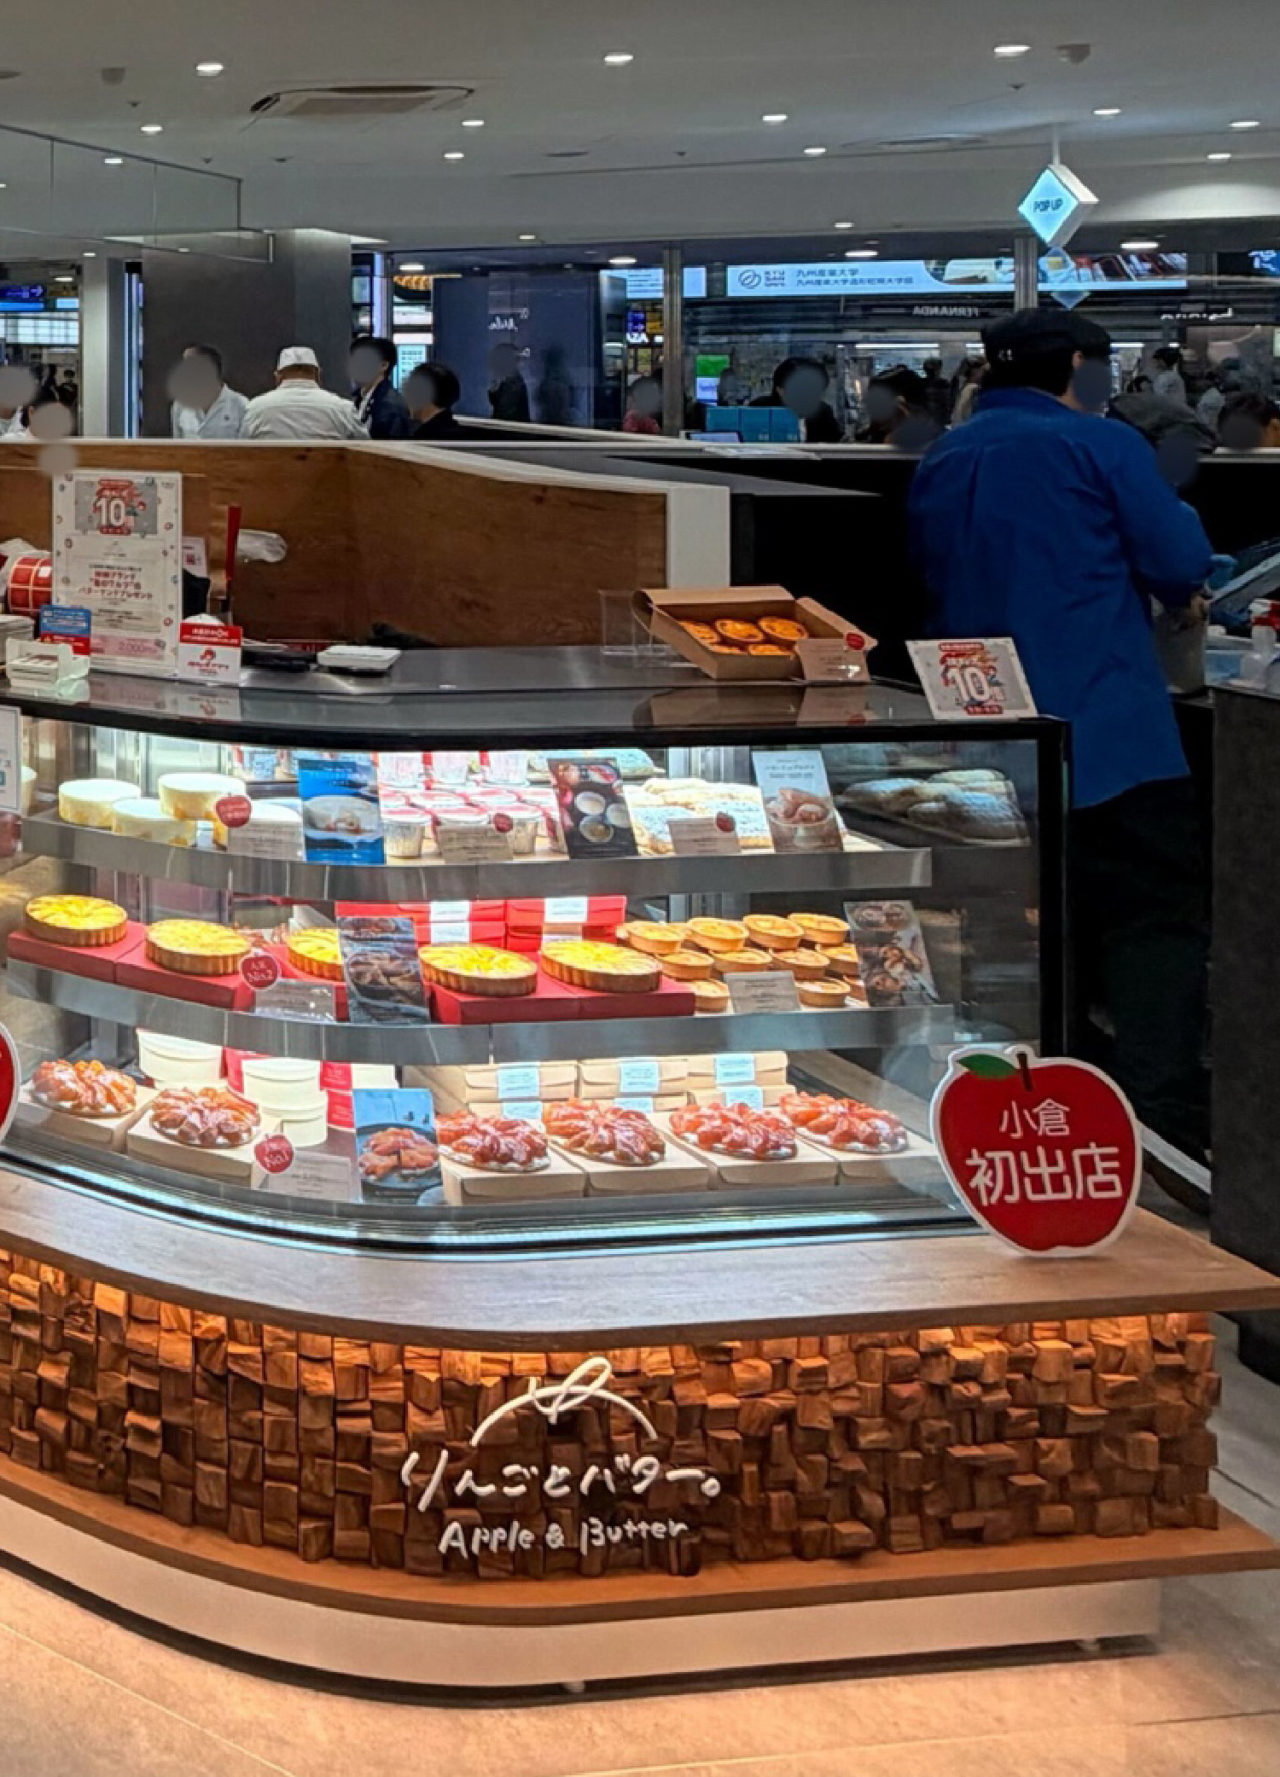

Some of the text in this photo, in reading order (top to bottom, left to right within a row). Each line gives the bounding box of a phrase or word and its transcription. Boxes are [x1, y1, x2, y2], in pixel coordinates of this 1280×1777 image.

[95, 498, 126, 527] 10
[947, 666, 991, 702] 10
[998, 1097, 1071, 1140] 小倉
[965, 1141, 1123, 1207] 初出店
[401, 1449, 720, 1513] りんごとバター。
[438, 1516, 690, 1559] Apple & Butter
